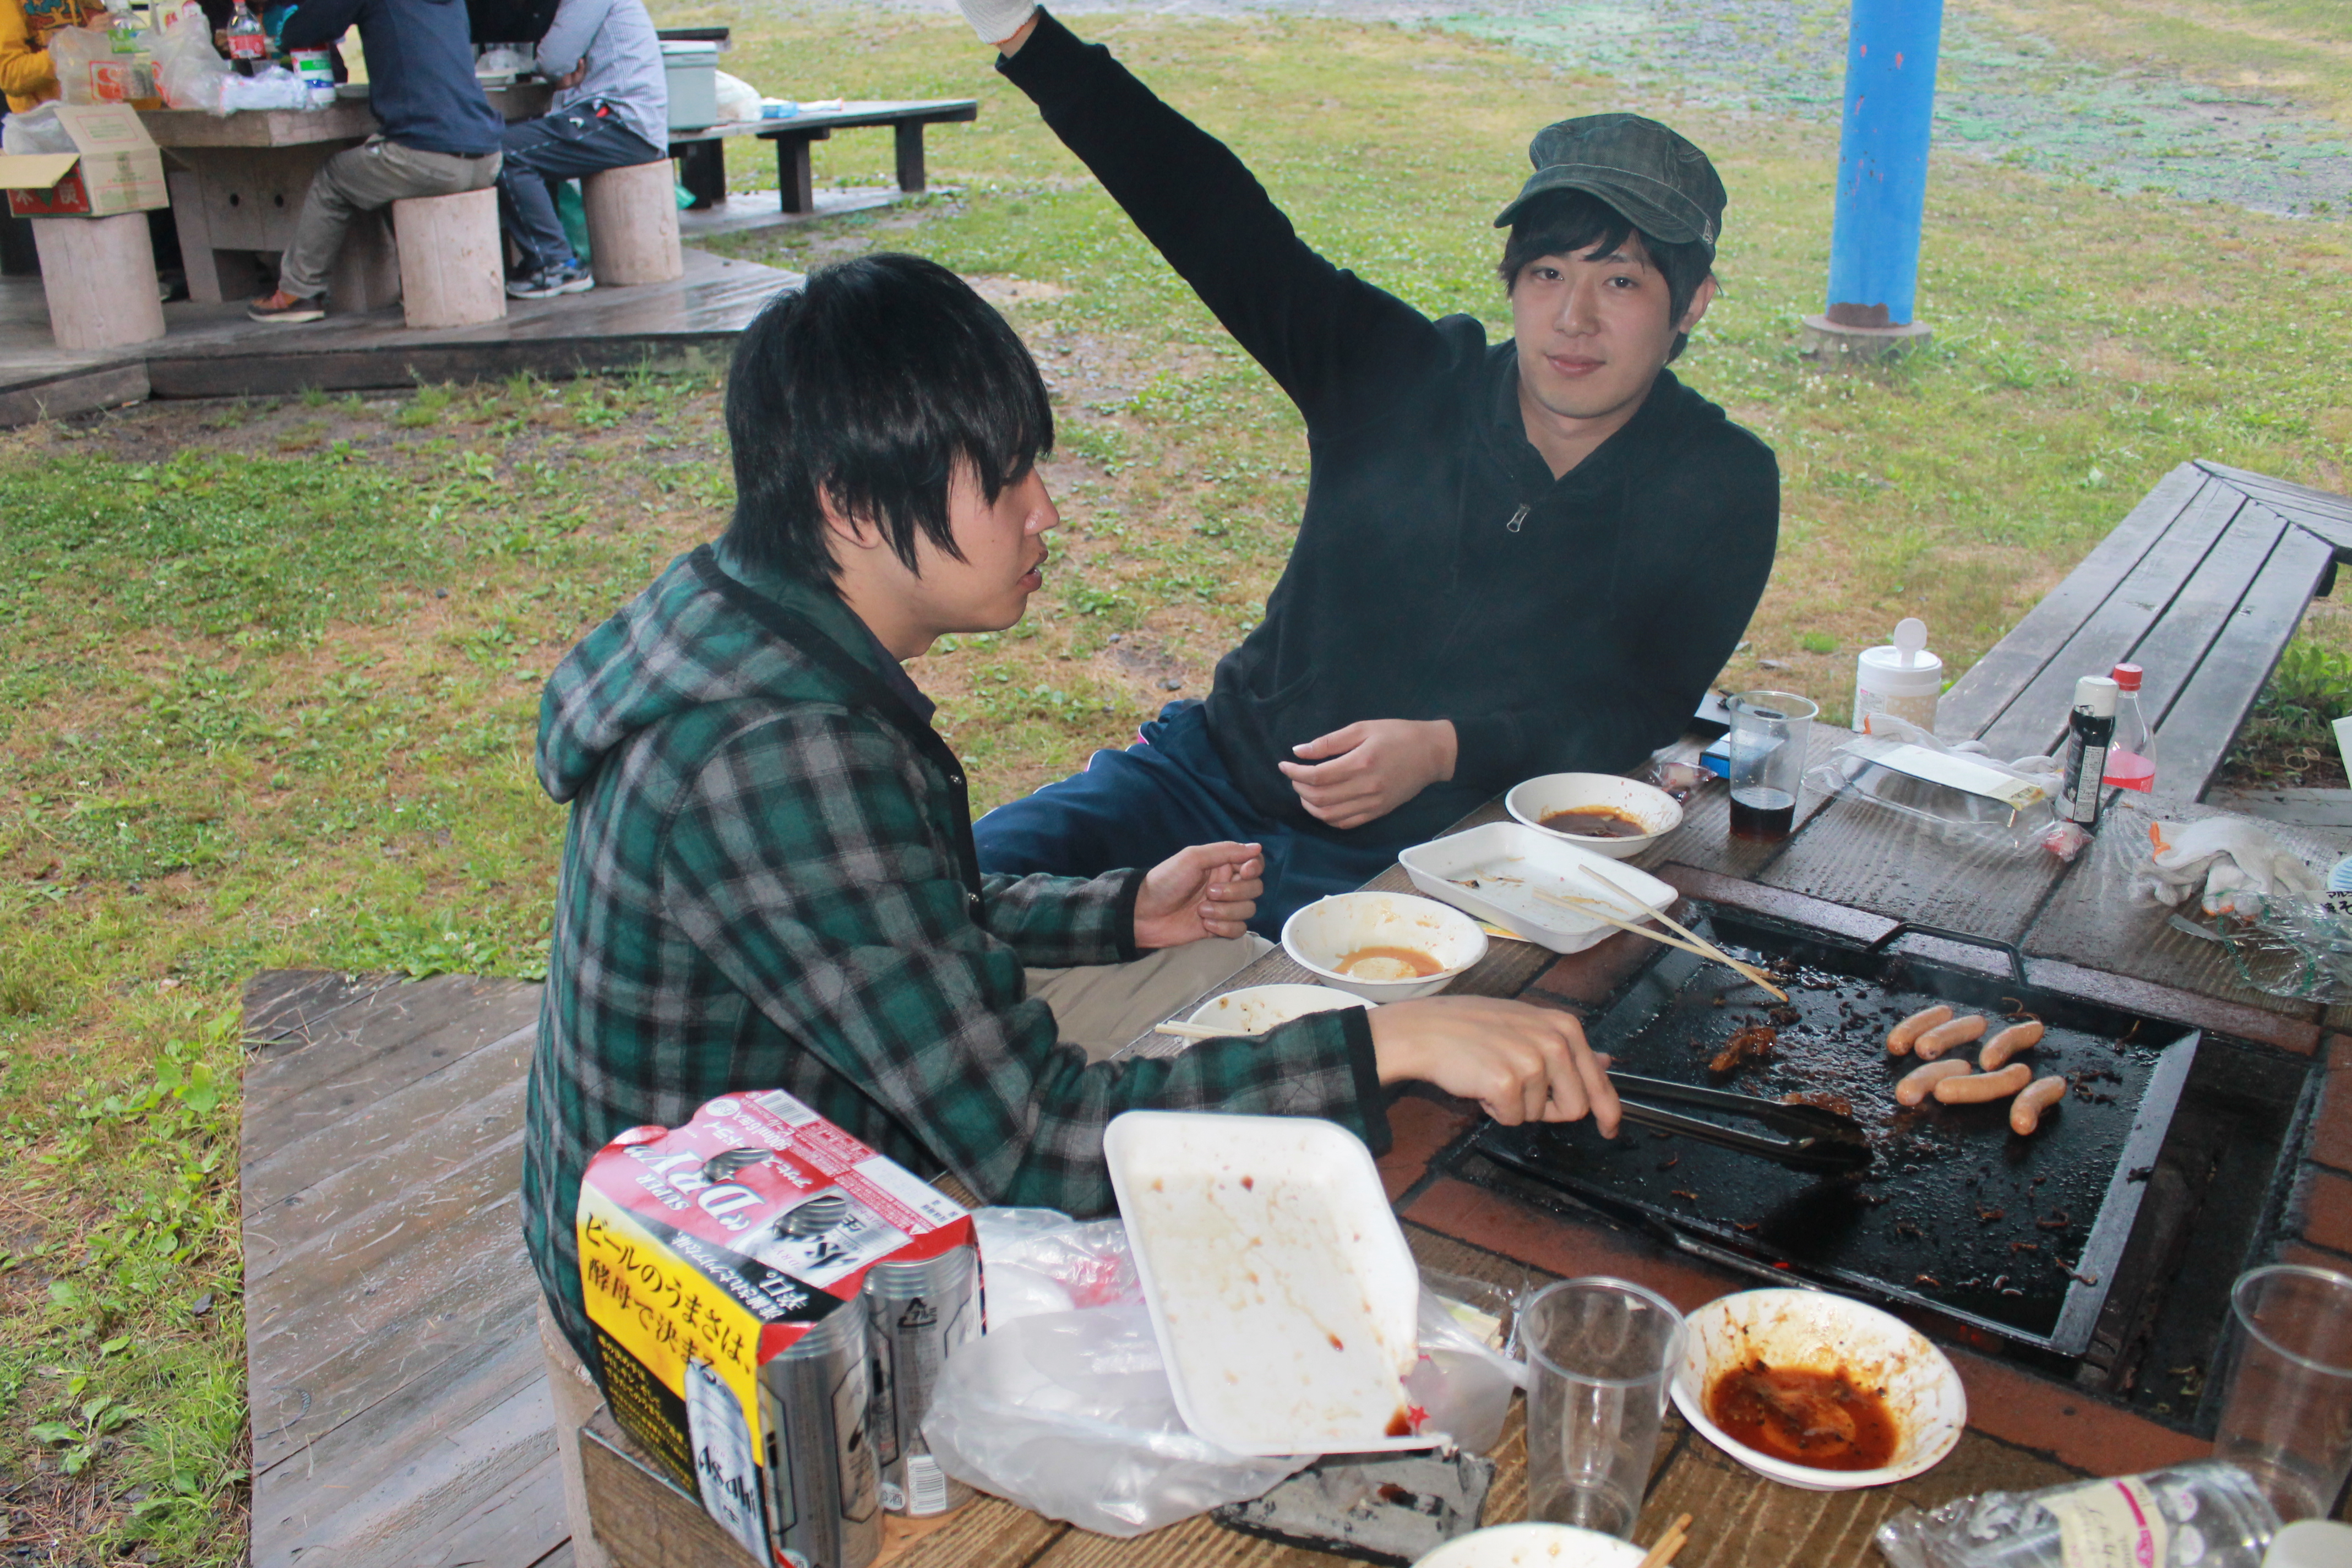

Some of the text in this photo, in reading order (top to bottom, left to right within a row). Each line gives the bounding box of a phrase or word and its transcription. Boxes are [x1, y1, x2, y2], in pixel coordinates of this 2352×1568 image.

[767, 1118, 796, 1137] ビール
[635, 1172, 691, 1211] SUPER
[586, 1212, 750, 1375] ビールのうまさは、
[759, 1268, 809, 1310] 辛口。
[589, 1256, 727, 1397] 酵母で決まる。
[698, 1446, 757, 1520] Asahi
